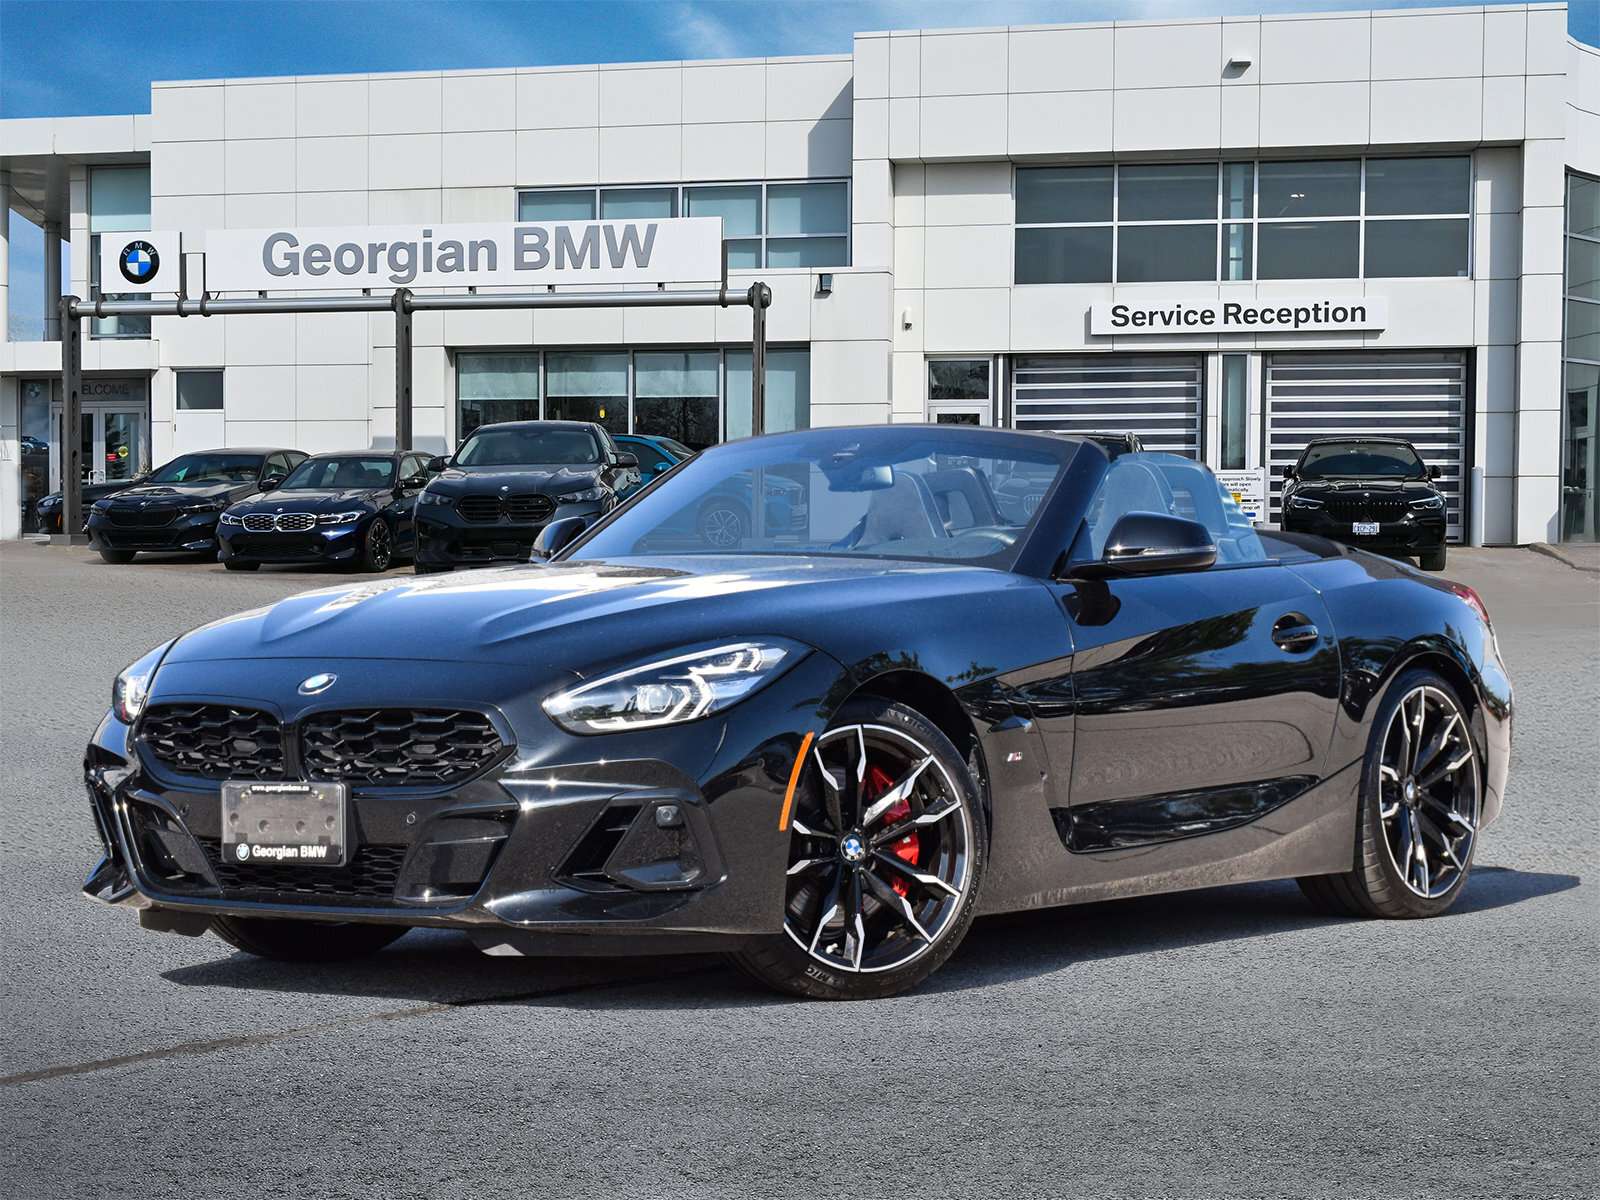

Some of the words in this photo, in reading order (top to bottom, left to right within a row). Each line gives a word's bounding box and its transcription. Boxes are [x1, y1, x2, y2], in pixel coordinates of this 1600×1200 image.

[122, 242, 157, 256] BMW
[262, 229, 498, 284] Georgian
[513, 223, 658, 271] BMW
[1111, 304, 1216, 328] Service
[1223, 300, 1367, 328] Reception
[81, 384, 129, 395] ELCOME
[252, 845, 298, 860] Georgian
[300, 846, 328, 859] BMW
